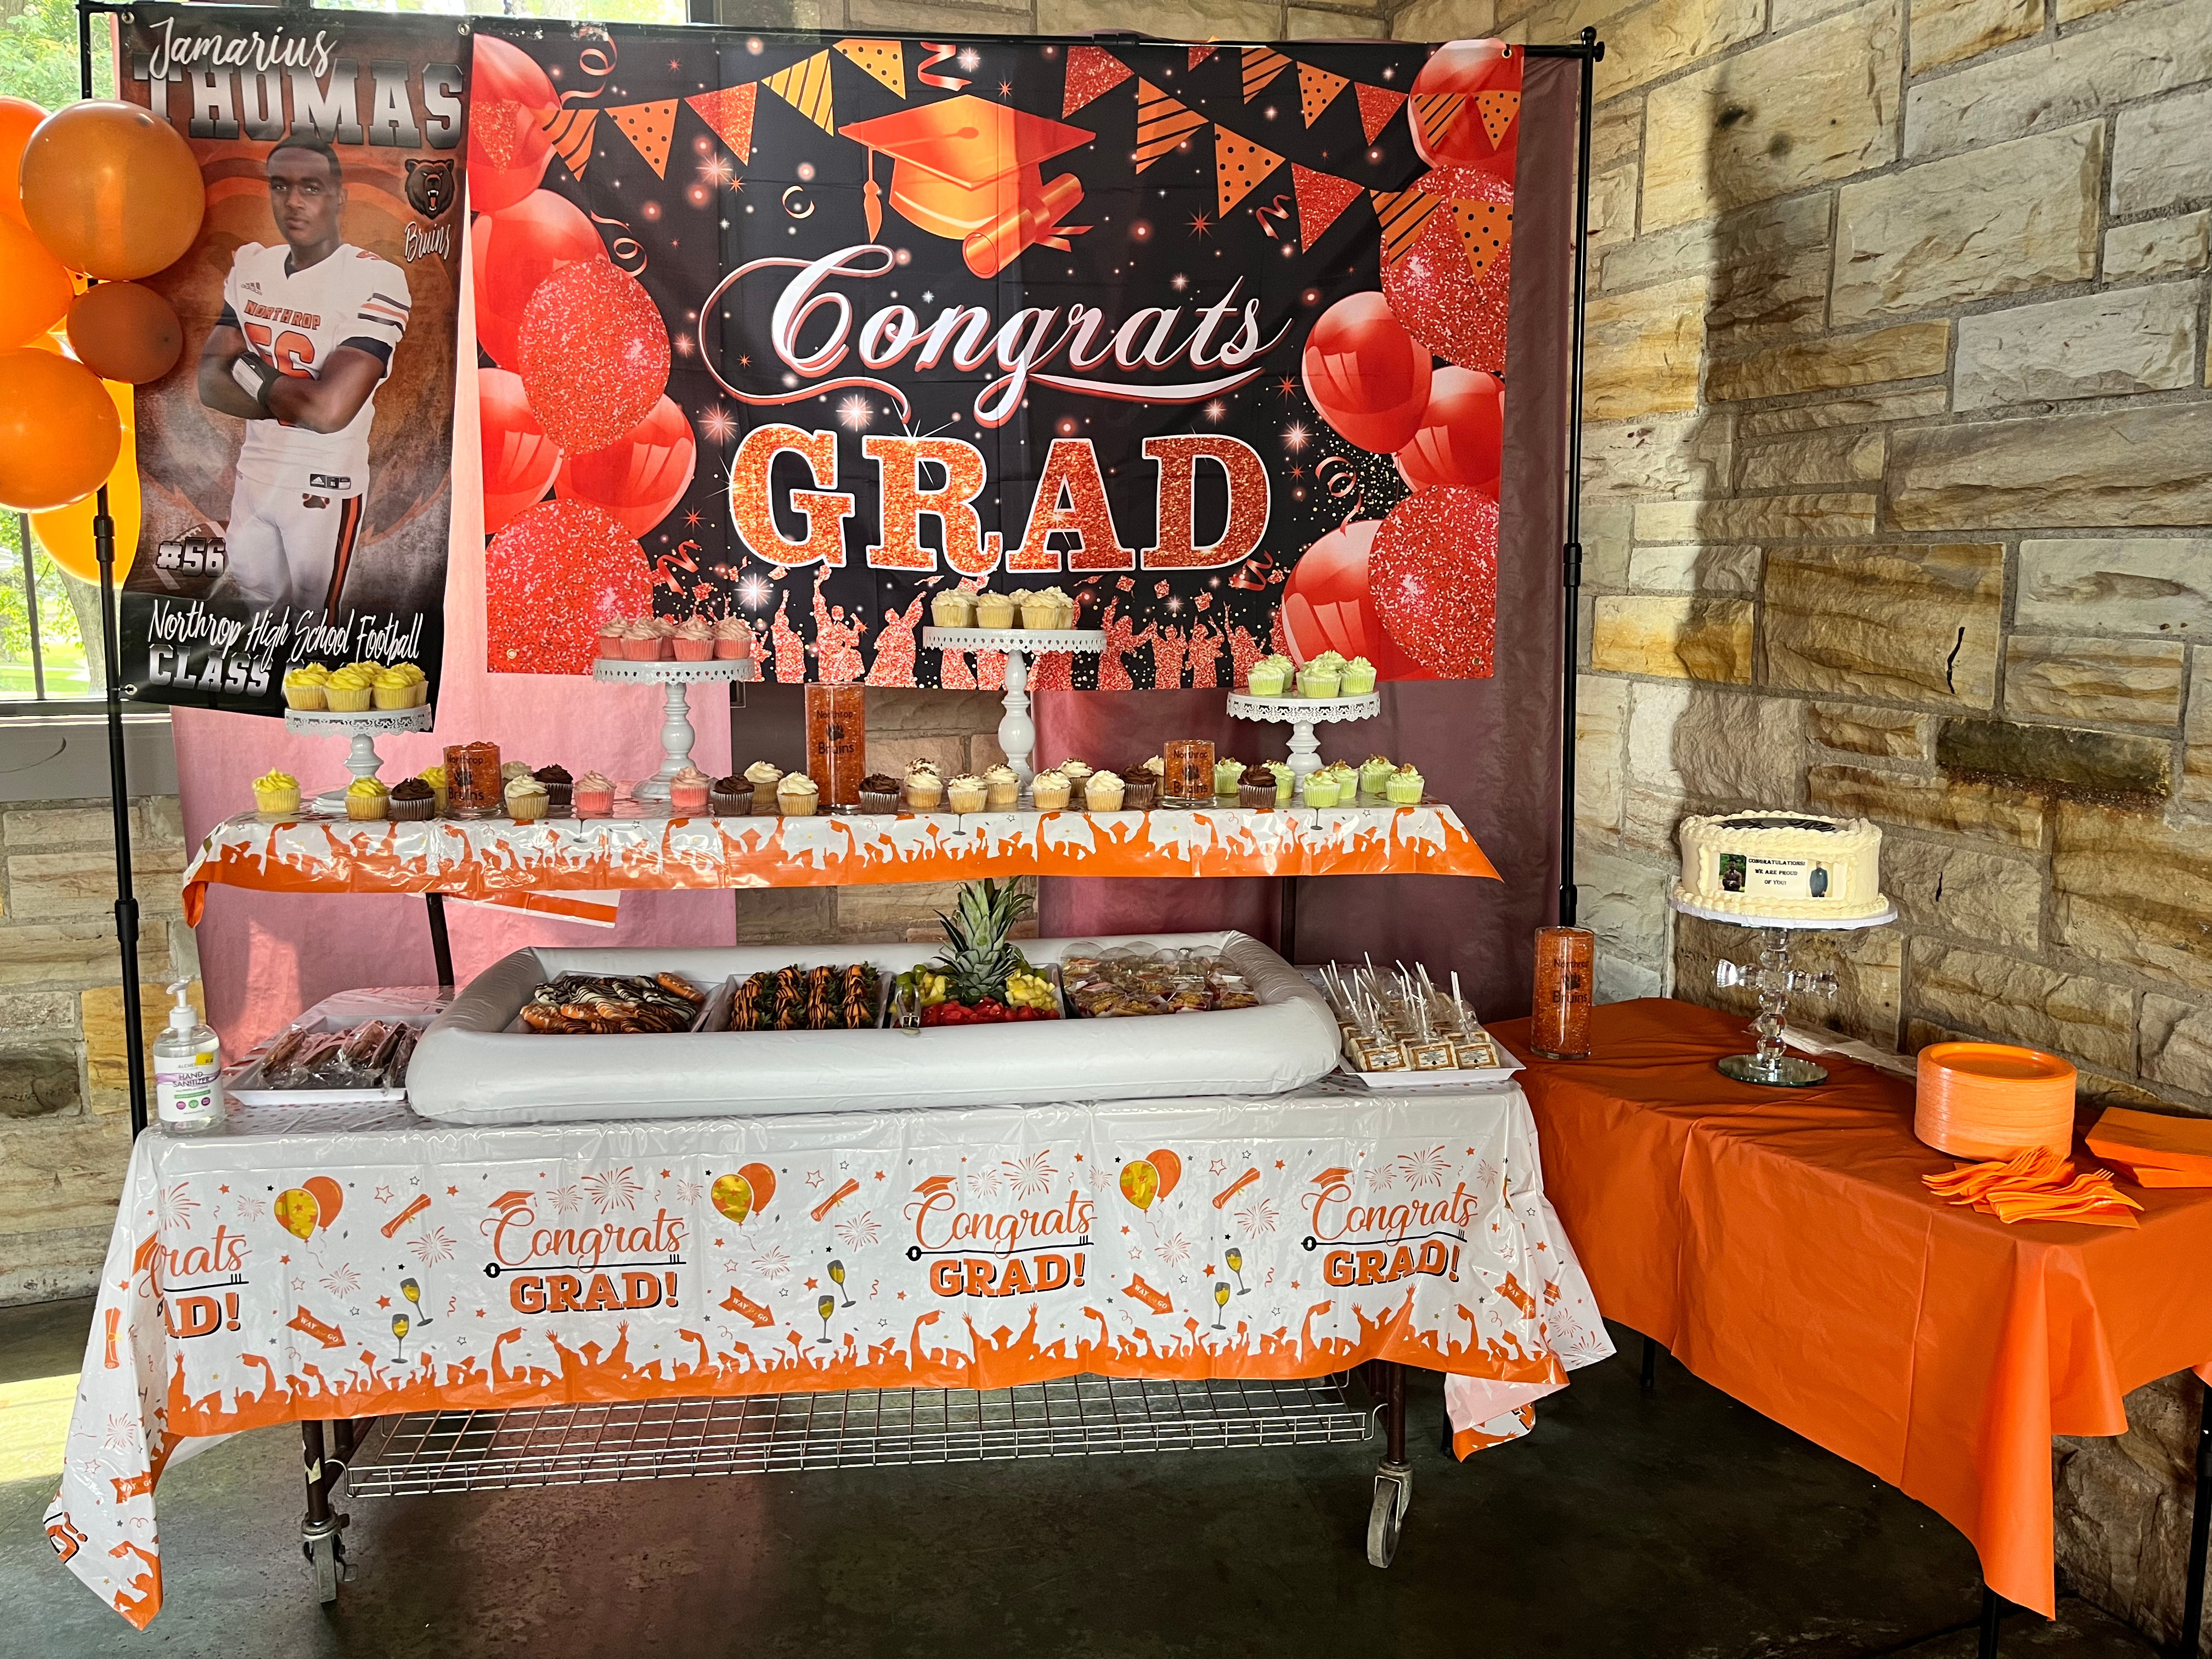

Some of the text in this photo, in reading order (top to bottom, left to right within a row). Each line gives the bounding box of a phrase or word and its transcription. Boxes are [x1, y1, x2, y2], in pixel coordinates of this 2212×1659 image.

[150, 17, 337, 78] Jamarius
[133, 53, 463, 149] THOMAS
[404, 221, 452, 262] Bruins
[244, 300, 321, 330] NORTHROP
[699, 244, 1291, 427] Congrats
[729, 424, 1270, 575] GRAD
[156, 537, 226, 577] #56
[148, 599, 424, 673] Northrop High School Football
[149, 644, 273, 697] CLASS
[173, 1076, 210, 1087] SANITIZER
[179, 1071, 203, 1080] HAND
[904, 1189, 1098, 1259] Congrats
[1301, 1182, 1479, 1247] Congrats
[479, 1207, 690, 1273] Congrats
[1323, 1238, 1460, 1287] GRAD!
[510, 1271, 679, 1314] GRAD!
[930, 1252, 1086, 1297] GRAD!
[1135, 1284, 1168, 1309] WAY GO
[1507, 1283, 1520, 1297] WAY
[300, 1317, 339, 1342] WAY GO
[733, 1297, 769, 1322] WAY GO
